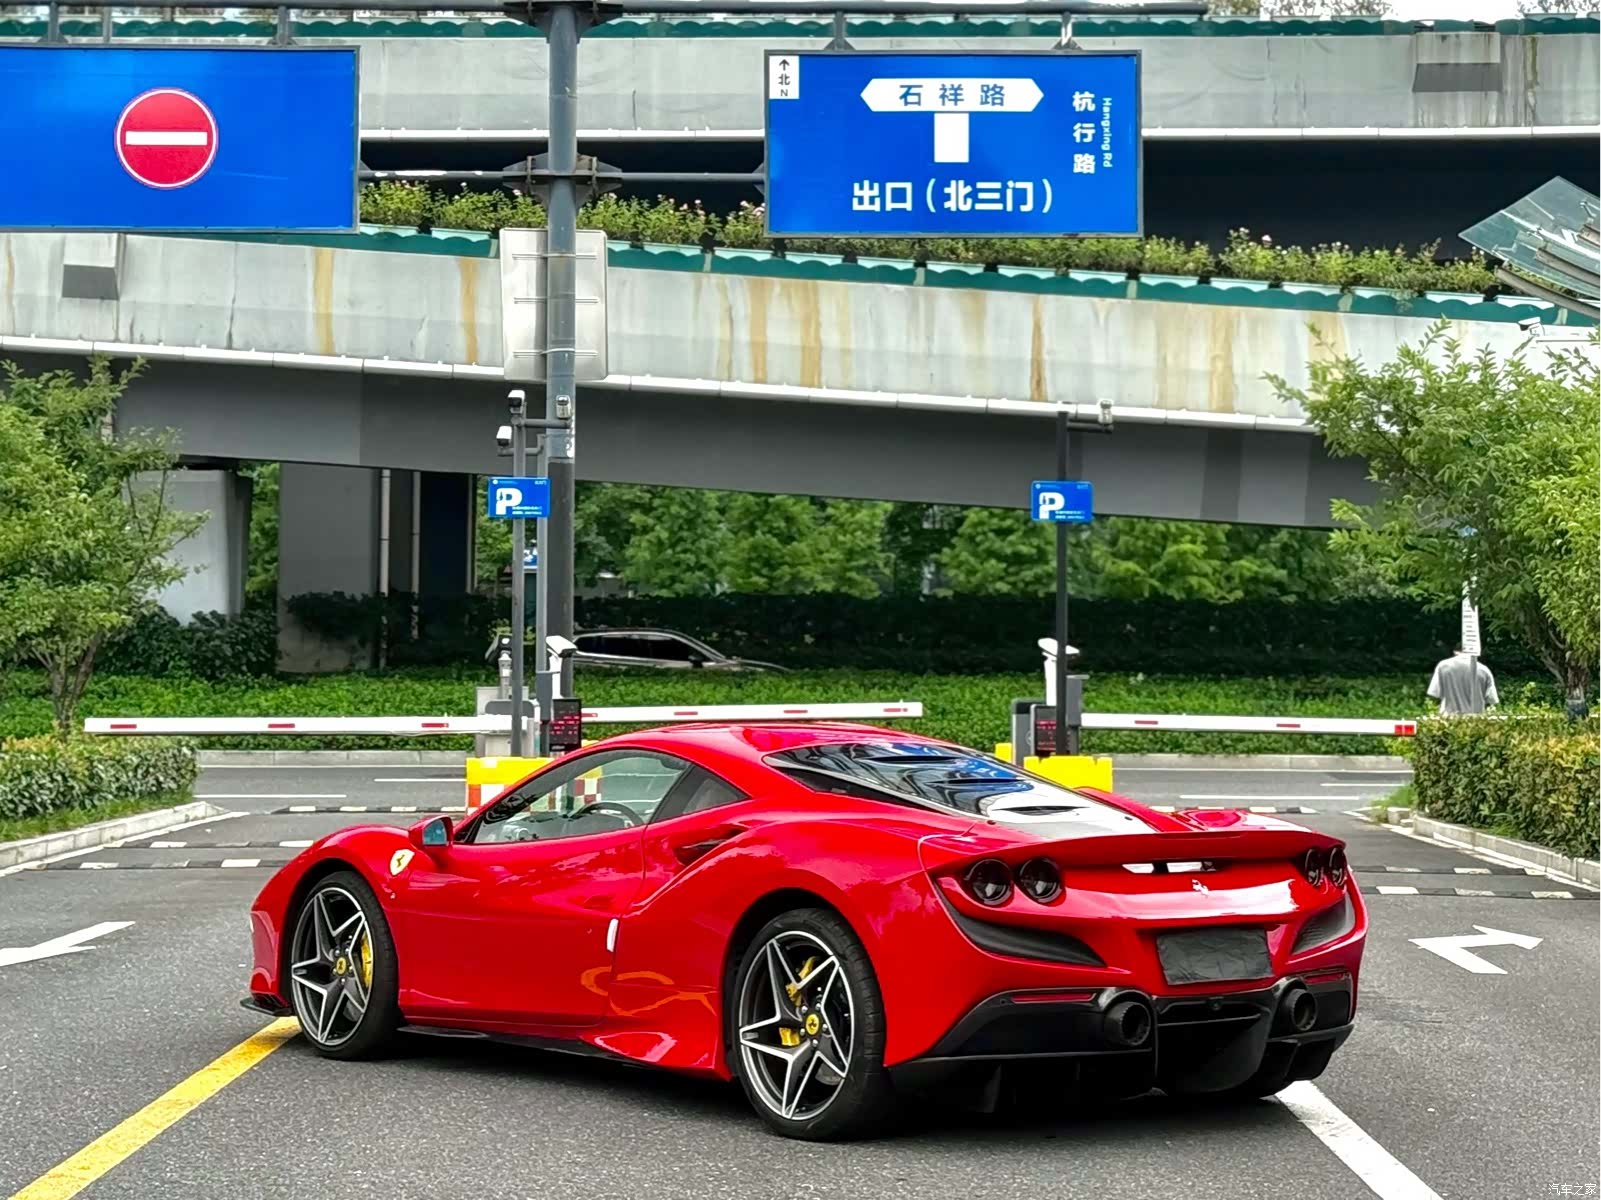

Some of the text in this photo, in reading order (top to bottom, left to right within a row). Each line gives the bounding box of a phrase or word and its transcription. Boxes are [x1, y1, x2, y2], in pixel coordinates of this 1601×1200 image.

[778, 73, 791, 86] 北
[780, 89, 789, 97] N
[899, 84, 1006, 107] 石祥路
[1072, 91, 1096, 174] 杭行路
[1101, 97, 1113, 168] Hangxing Rd
